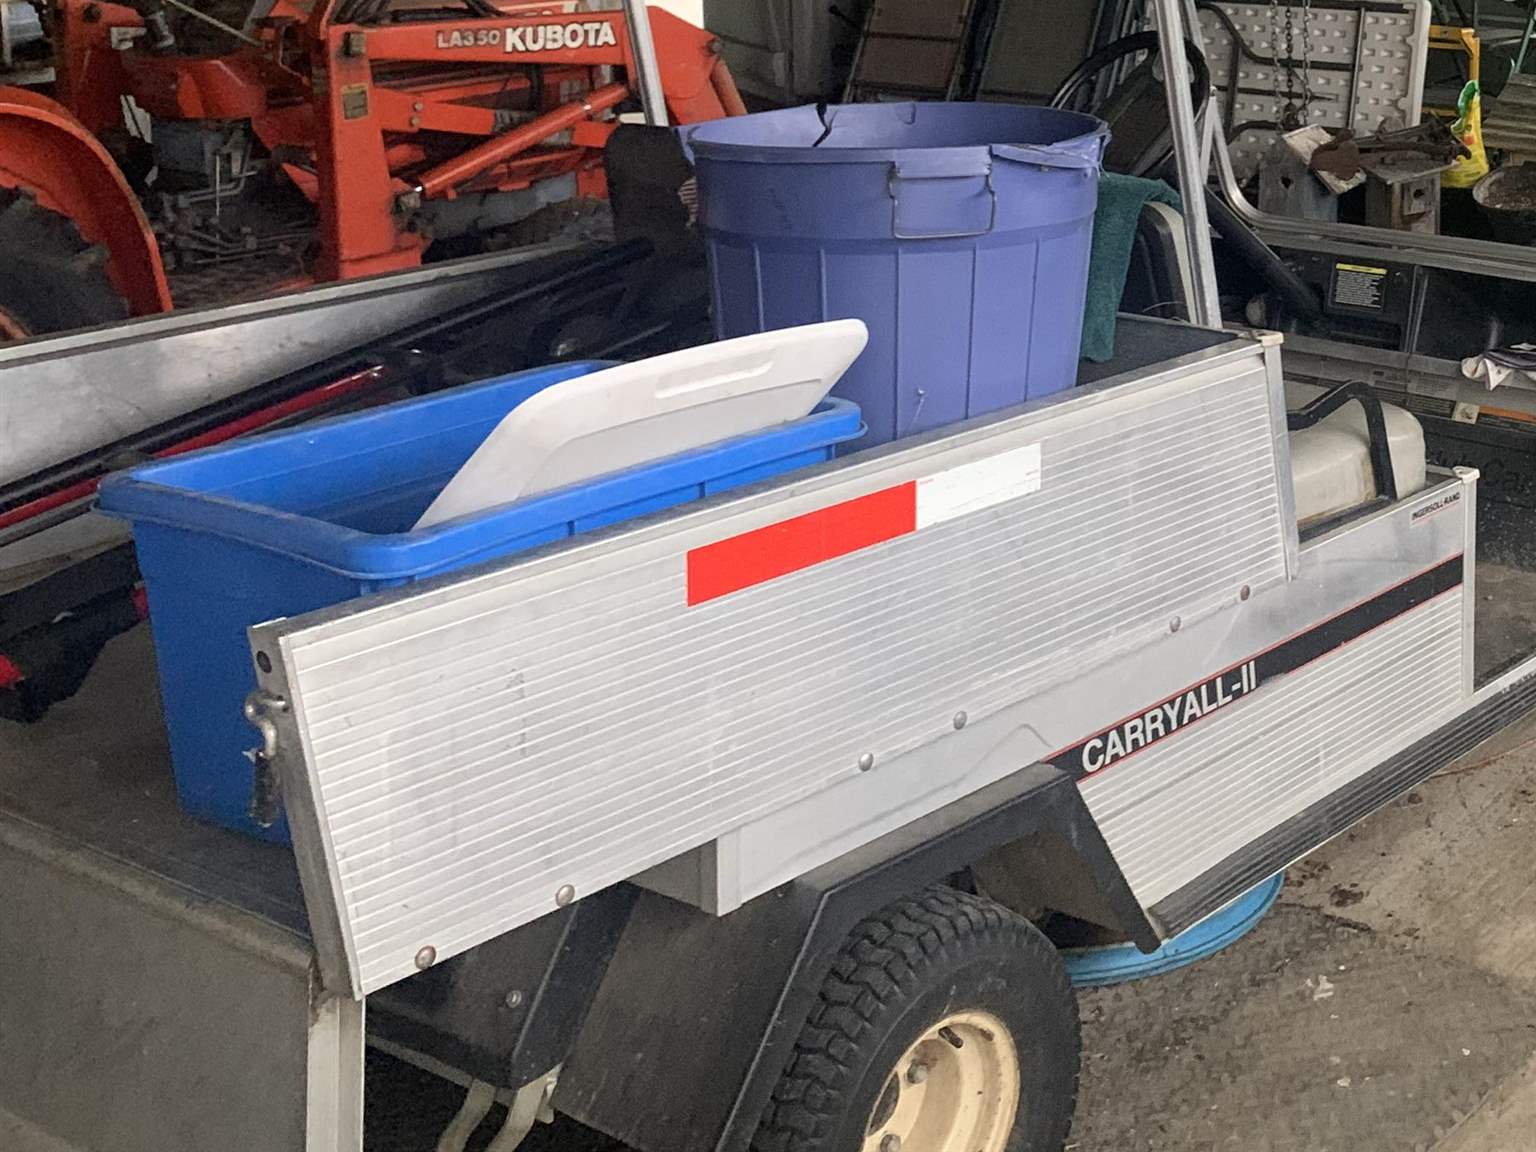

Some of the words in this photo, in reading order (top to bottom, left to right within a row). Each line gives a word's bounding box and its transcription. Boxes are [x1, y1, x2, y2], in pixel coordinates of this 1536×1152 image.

[438, 29, 500, 48] LA350
[504, 21, 616, 53] KUBOTA
[1082, 660, 1257, 774] CARRYALL-II
